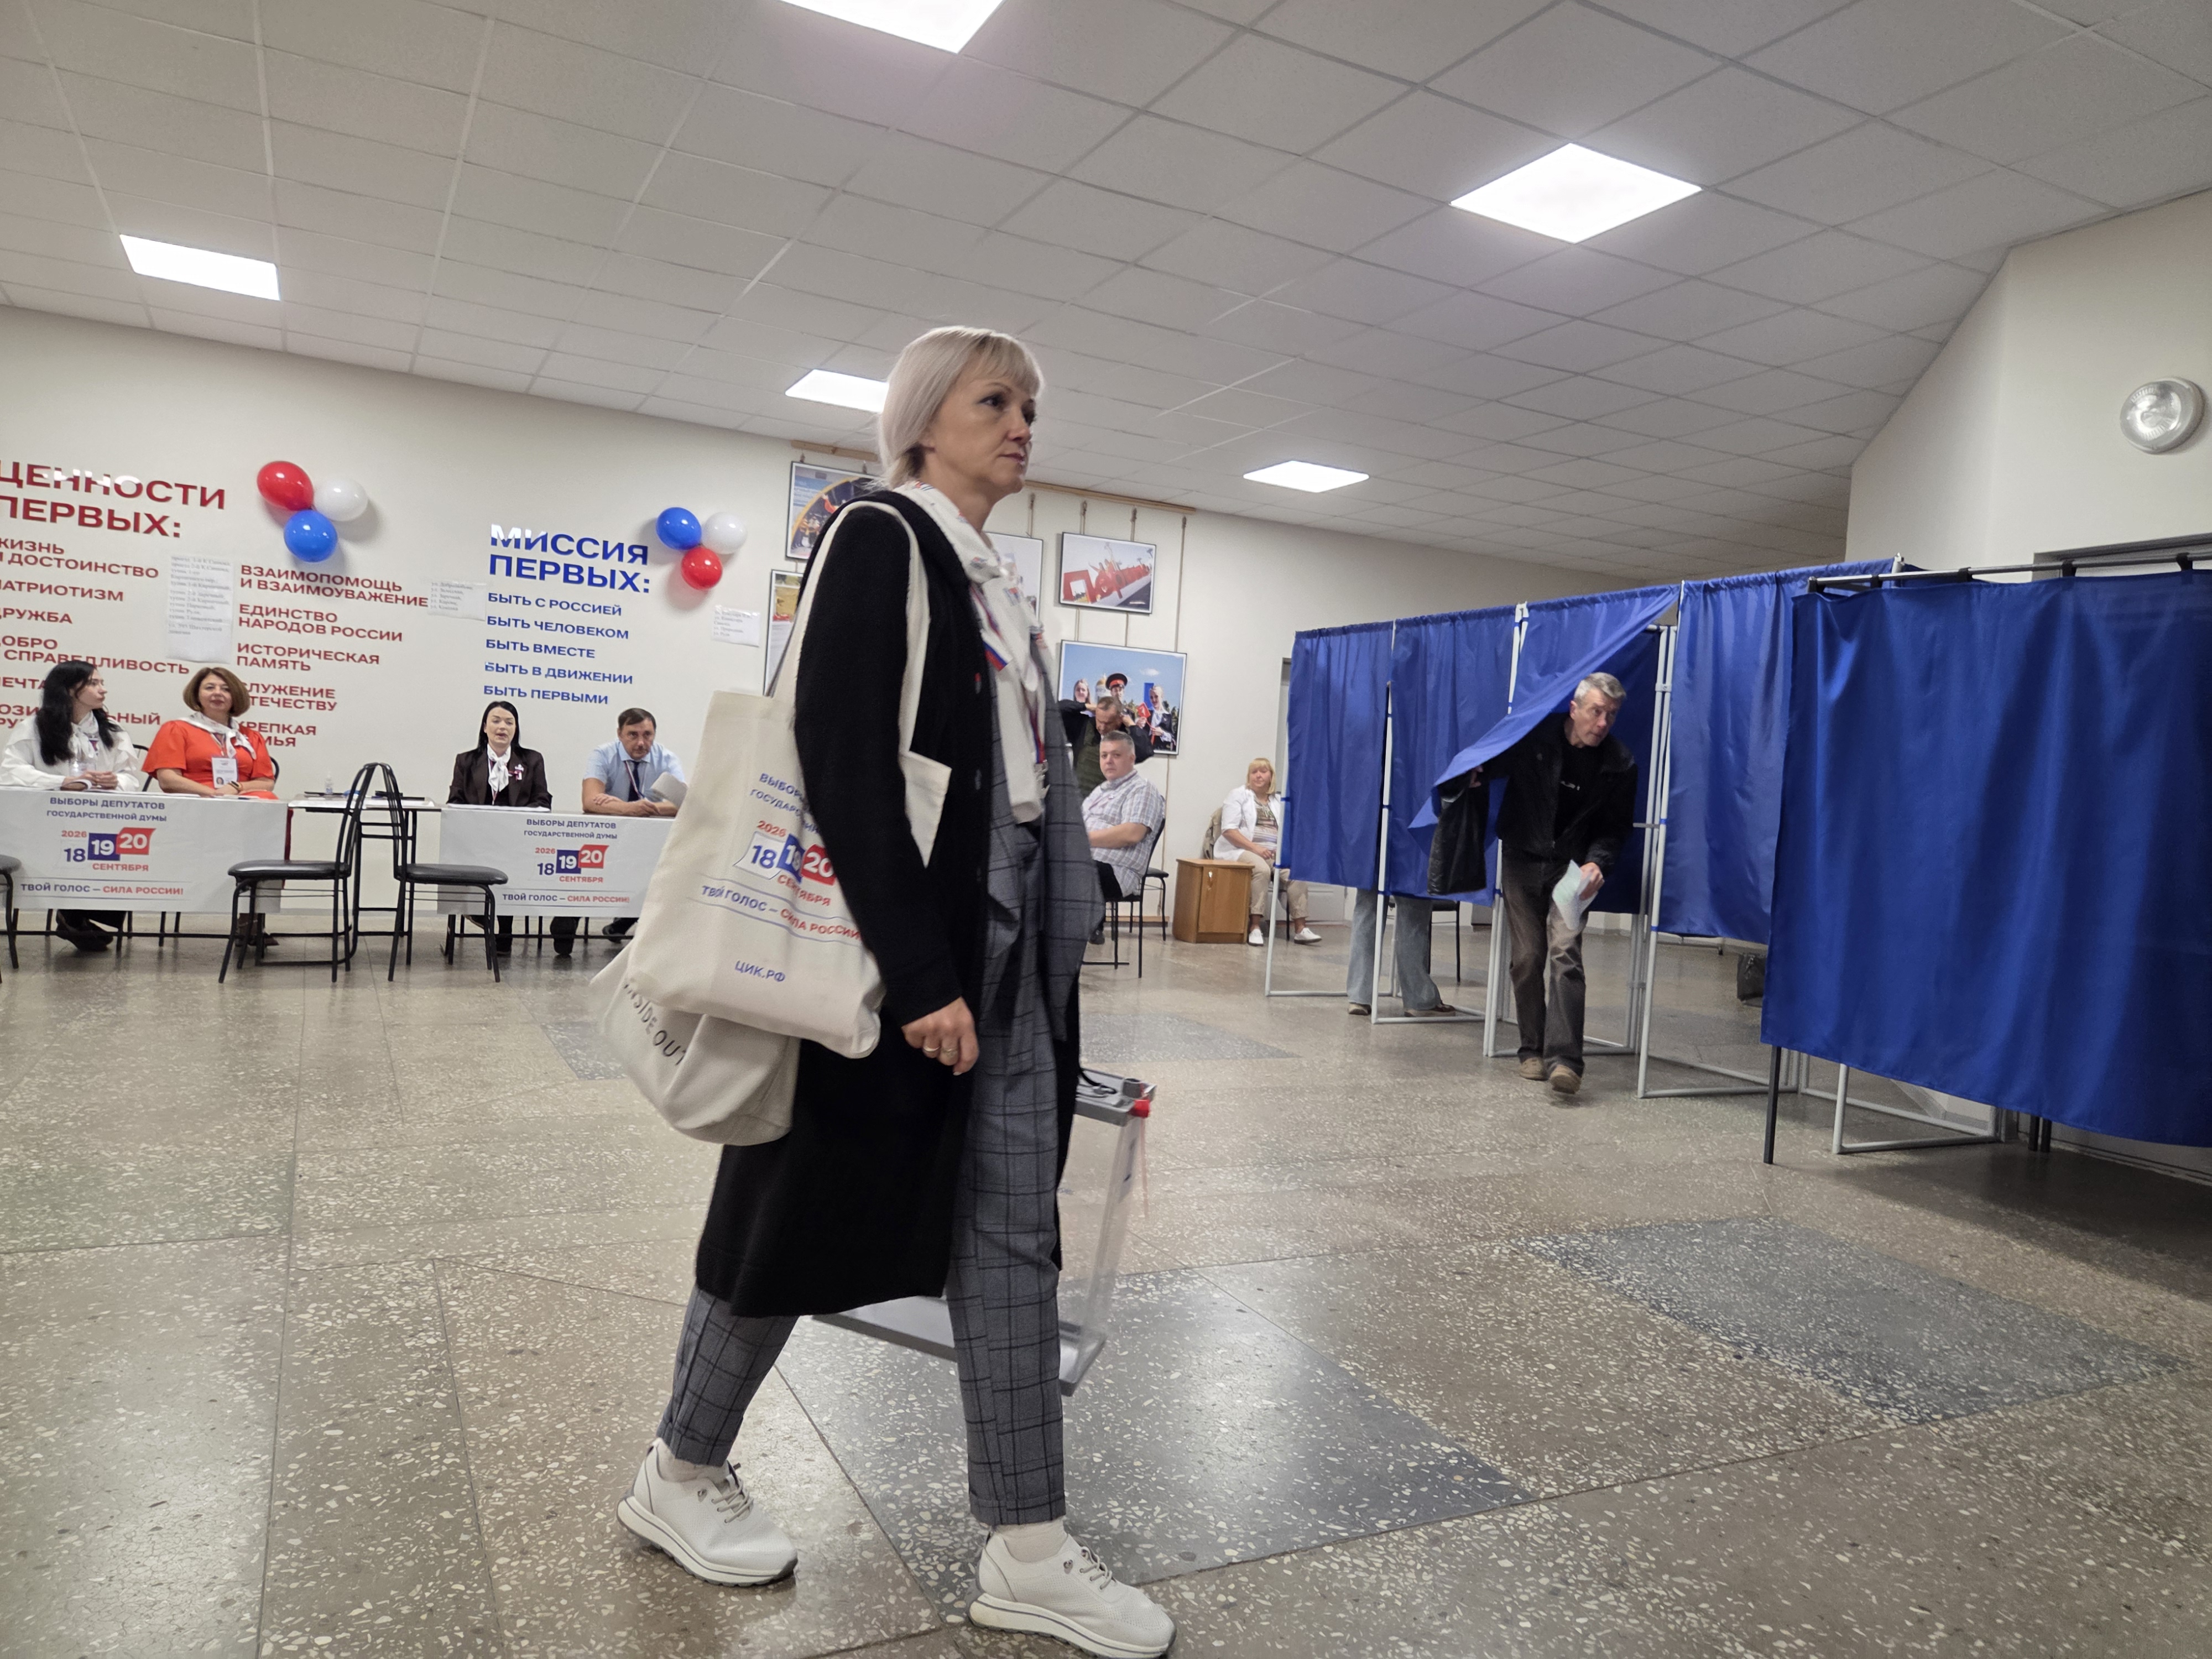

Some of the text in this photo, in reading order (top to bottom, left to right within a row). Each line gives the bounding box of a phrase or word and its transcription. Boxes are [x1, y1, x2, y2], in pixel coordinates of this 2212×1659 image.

[0, 460, 225, 509] ЦЕННОСТИ
[0, 495, 181, 538] ПЕРВЫХ:
[491, 524, 648, 565] МИССИЯ
[8, 552, 159, 578] ДОСТОИНСТВО
[490, 554, 650, 593] ПЕРВЫХ:
[241, 565, 402, 592] ВЗАИМОПОМОЩЬ
[0, 579, 124, 601] АТРИОТИЗМ
[240, 578, 252, 588] И
[257, 581, 429, 607] ВЗАИМОУВАЖЕНИЕ
[239, 604, 338, 623] ЕДИНСТВО
[488, 592, 622, 616] БЫТЬ С РОССИЕЙ
[0, 607, 73, 624] РУЖБА
[238, 617, 326, 635] НАРОДОВ
[331, 625, 403, 641] РОССИИ
[487, 616, 629, 639] БЫТЬ ЧЕЛОВЕКОМ
[0, 635, 58, 650] ОБРО
[486, 639, 596, 658] БЫТЬ ВМЕСТЕ
[237, 643, 380, 665] ИСТОРИЧЕСКАЯ
[237, 656, 311, 671] ПАМЯТЬ
[484, 662, 633, 685] БЫТЬ В ДВИЖЕНИИ
[242, 682, 336, 699] ЛУЖЕНИЕ
[483, 685, 608, 705] БЫТЬ ПЕРВЫМИ
[249, 696, 337, 711] ТЕЧЕСТВУ
[50, 797, 165, 810] ВЫБОРЫ ДЕПУТАТОВ
[46, 810, 137, 821] ГОСУДАРСТВЕННОЙ
[526, 819, 617, 829] ВЫБОРЫ ДЕПУТАТОВ
[524, 830, 594, 839] ГОСУДАРСТВЕННОЙ
[64, 833, 148, 862] 18 19 20
[92, 863, 149, 872] СЕНТЯБРЯ
[537, 850, 603, 875] 18 19 20
[751, 845, 778, 869] 18
[804, 852, 834, 878] 20
[21, 882, 51, 892] ТВОЙ
[54, 884, 90, 893] ГОЛОС
[103, 885, 133, 894] СИЛА
[136, 886, 184, 895] РОССИИ!
[502, 893, 526, 901] ТВОЙ
[724, 889, 768, 911] ГОЛОС
[734, 960, 786, 982] ЦИК.РФ
